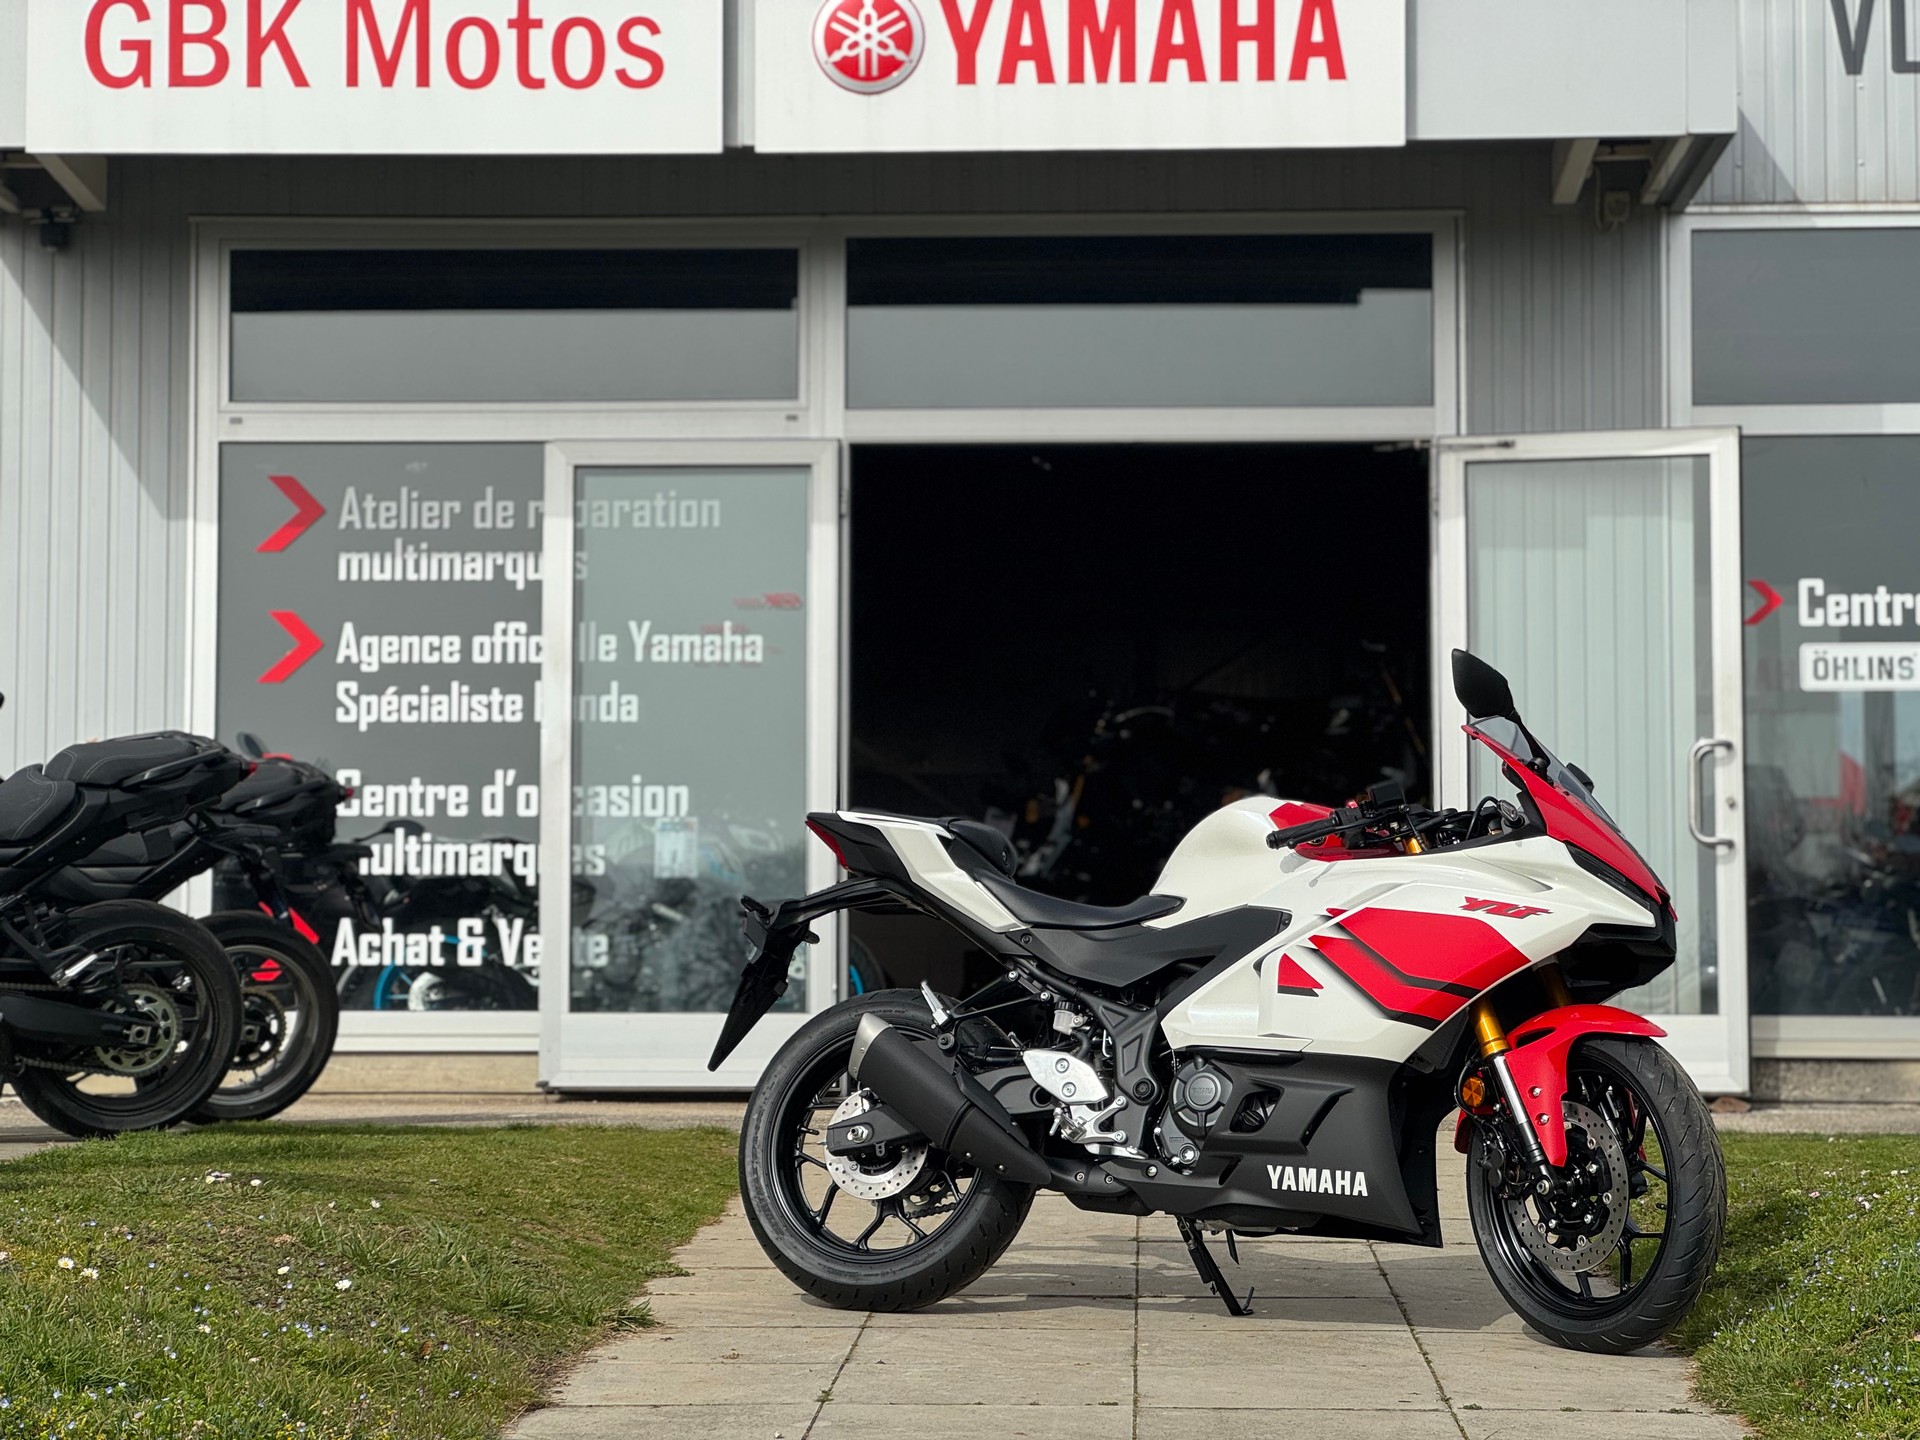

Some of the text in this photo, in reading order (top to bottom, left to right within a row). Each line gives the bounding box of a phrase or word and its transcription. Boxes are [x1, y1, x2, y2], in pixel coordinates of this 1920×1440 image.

[83, 0, 666, 91] GBK Motos
[938, 0, 1348, 85] YAMAHA
[338, 486, 461, 530] Atelier
[473, 486, 515, 530] de
[338, 537, 589, 591] multimarqus
[1797, 577, 1920, 627] Centr
[335, 620, 764, 673] Agence officlle Yamaha
[1812, 650, 1915, 681] ÖHLINS
[335, 680, 639, 732] Spécialiste nda
[335, 768, 469, 817] Centre
[330, 917, 609, 967] Achat & Vete
[1266, 1164, 1368, 1197] YAMAHA
